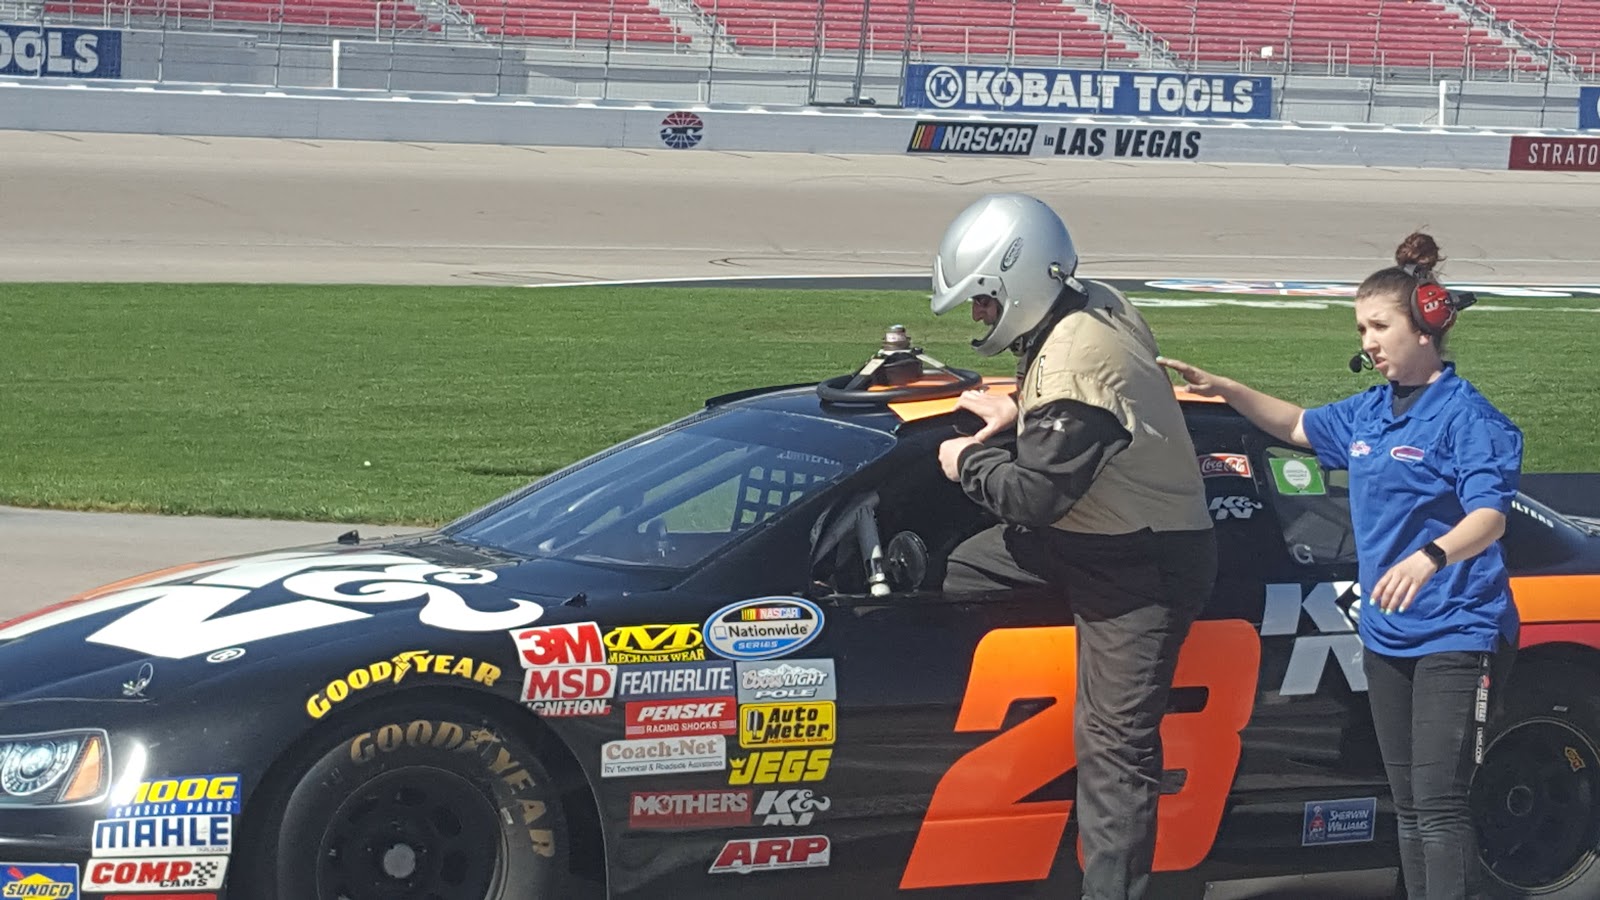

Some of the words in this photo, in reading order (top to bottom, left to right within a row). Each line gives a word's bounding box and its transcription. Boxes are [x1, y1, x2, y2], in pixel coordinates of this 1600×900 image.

[965, 70, 1120, 109] KOBALT
[1134, 76, 1254, 114] TOOLS
[941, 126, 1032, 153] NASCAR
[1044, 134, 1054, 147] in
[1056, 127, 1105, 156] LAS
[1114, 129, 1202, 159] VEGAS
[1528, 143, 1599, 166] STRATO
[759, 607, 800, 620] NASCAR
[728, 624, 808, 638] Nationwide
[519, 624, 603, 665] 3M
[738, 641, 779, 650] SERIES
[608, 652, 670, 664] MECHANIX
[671, 648, 706, 661] WEAR
[527, 667, 612, 700] MSD
[620, 667, 732, 696] FEATHERLITE
[784, 672, 828, 687] LIGHT
[754, 688, 818, 699] POLE
[637, 702, 727, 722] PENSKE
[768, 706, 819, 723] Auto
[646, 723, 679, 733] RACING
[681, 721, 718, 731] SHOCKS
[764, 723, 830, 741] Meter
[605, 739, 717, 760] Coach-Net
[616, 763, 648, 773] Technical
[655, 761, 687, 771] Roadside
[728, 749, 834, 785] JEGS
[115, 803, 177, 818] CHASSIS
[186, 801, 233, 813] PARTS
[633, 793, 749, 817] MOTHERS
[754, 789, 831, 826] K&N
[1329, 809, 1370, 821] SHERWIN
[95, 816, 229, 849] MAHLE
[1327, 820, 1368, 832] WILLIAMS
[714, 837, 829, 867] ARP
[91, 860, 193, 885] COMP
[6, 883, 71, 897] SUNOCO
[159, 877, 208, 888] CAMS
